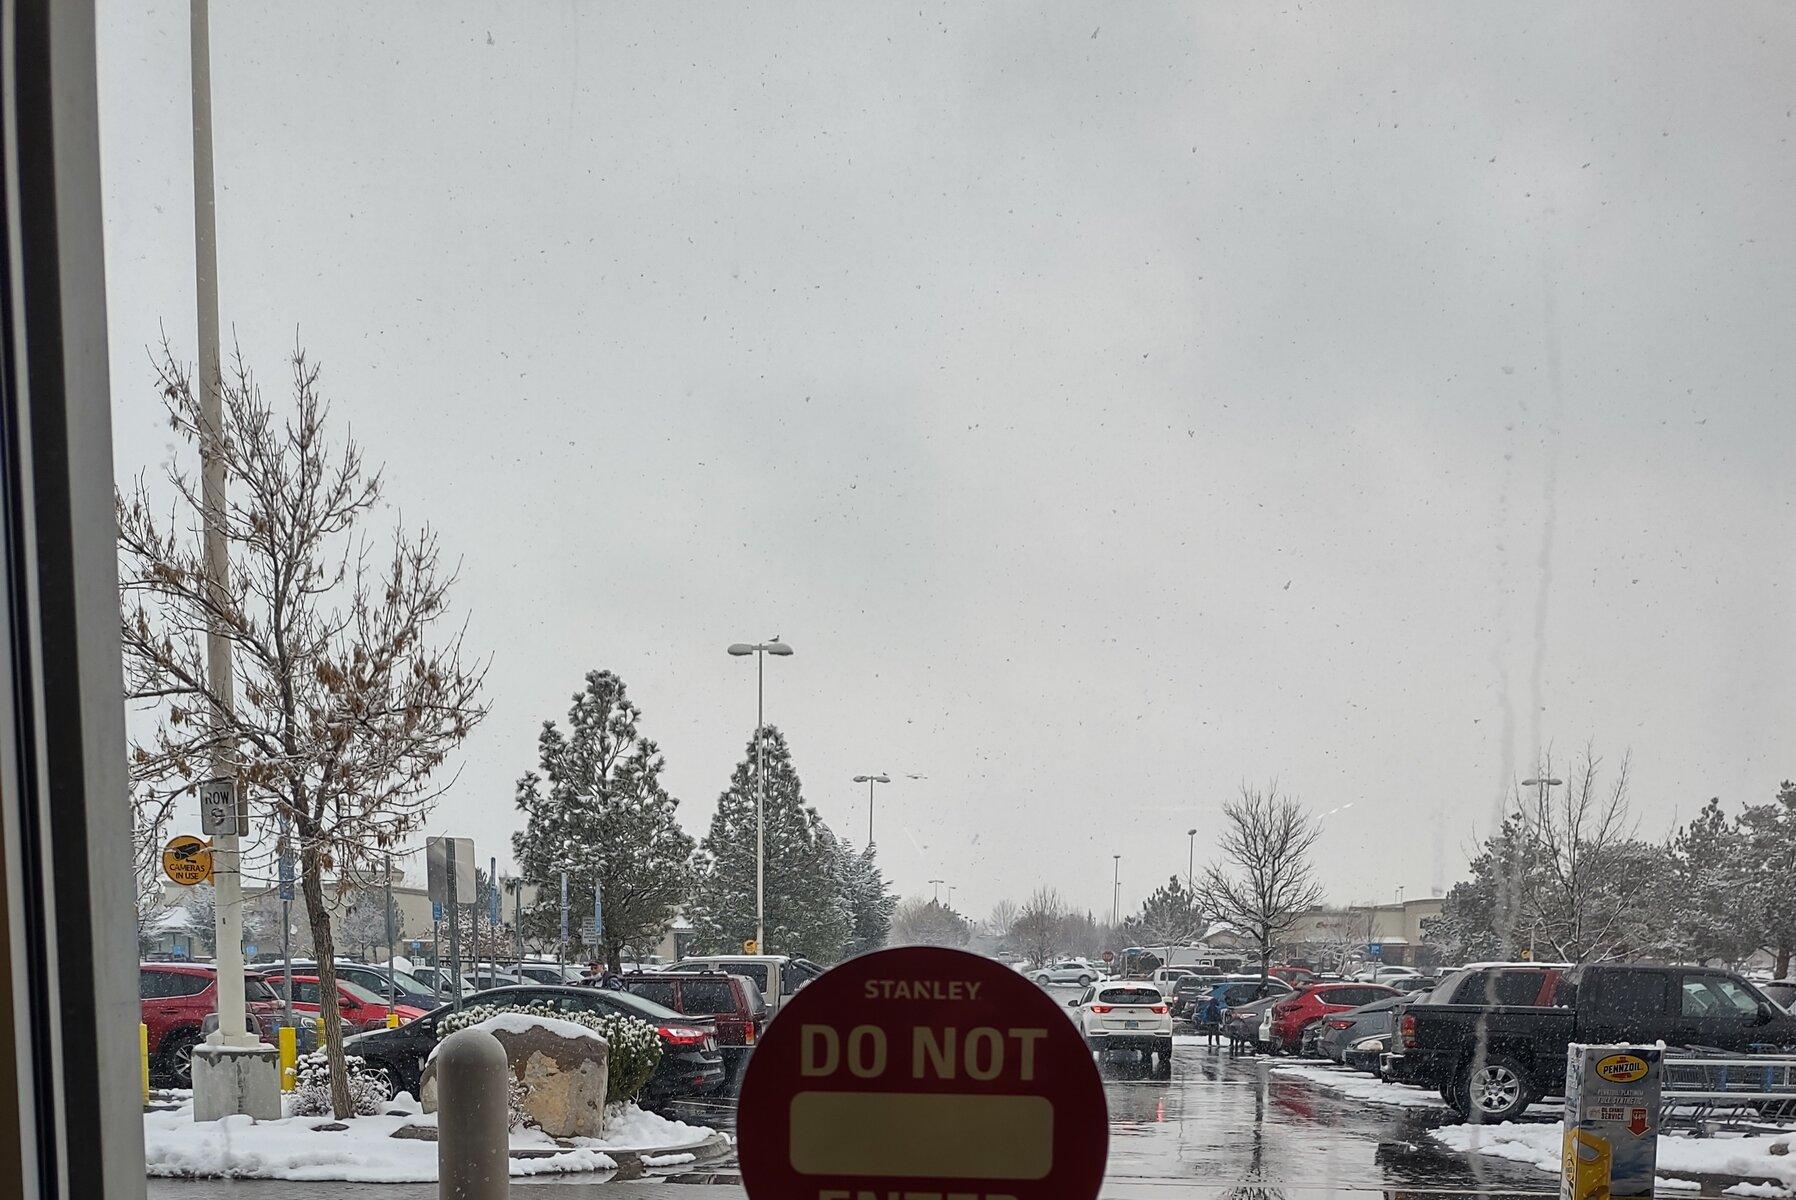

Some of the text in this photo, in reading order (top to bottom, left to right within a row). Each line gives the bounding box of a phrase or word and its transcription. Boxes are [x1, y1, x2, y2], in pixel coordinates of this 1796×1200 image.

[205, 791, 229, 805] ROW
[169, 864, 205, 872] CAMERAS
[864, 979, 982, 1001] STANLEY
[800, 1024, 1048, 1081] DO NOT
[1603, 1062, 1643, 1074] PENNZOIL
[1601, 1112, 1624, 1120] SERVICE
